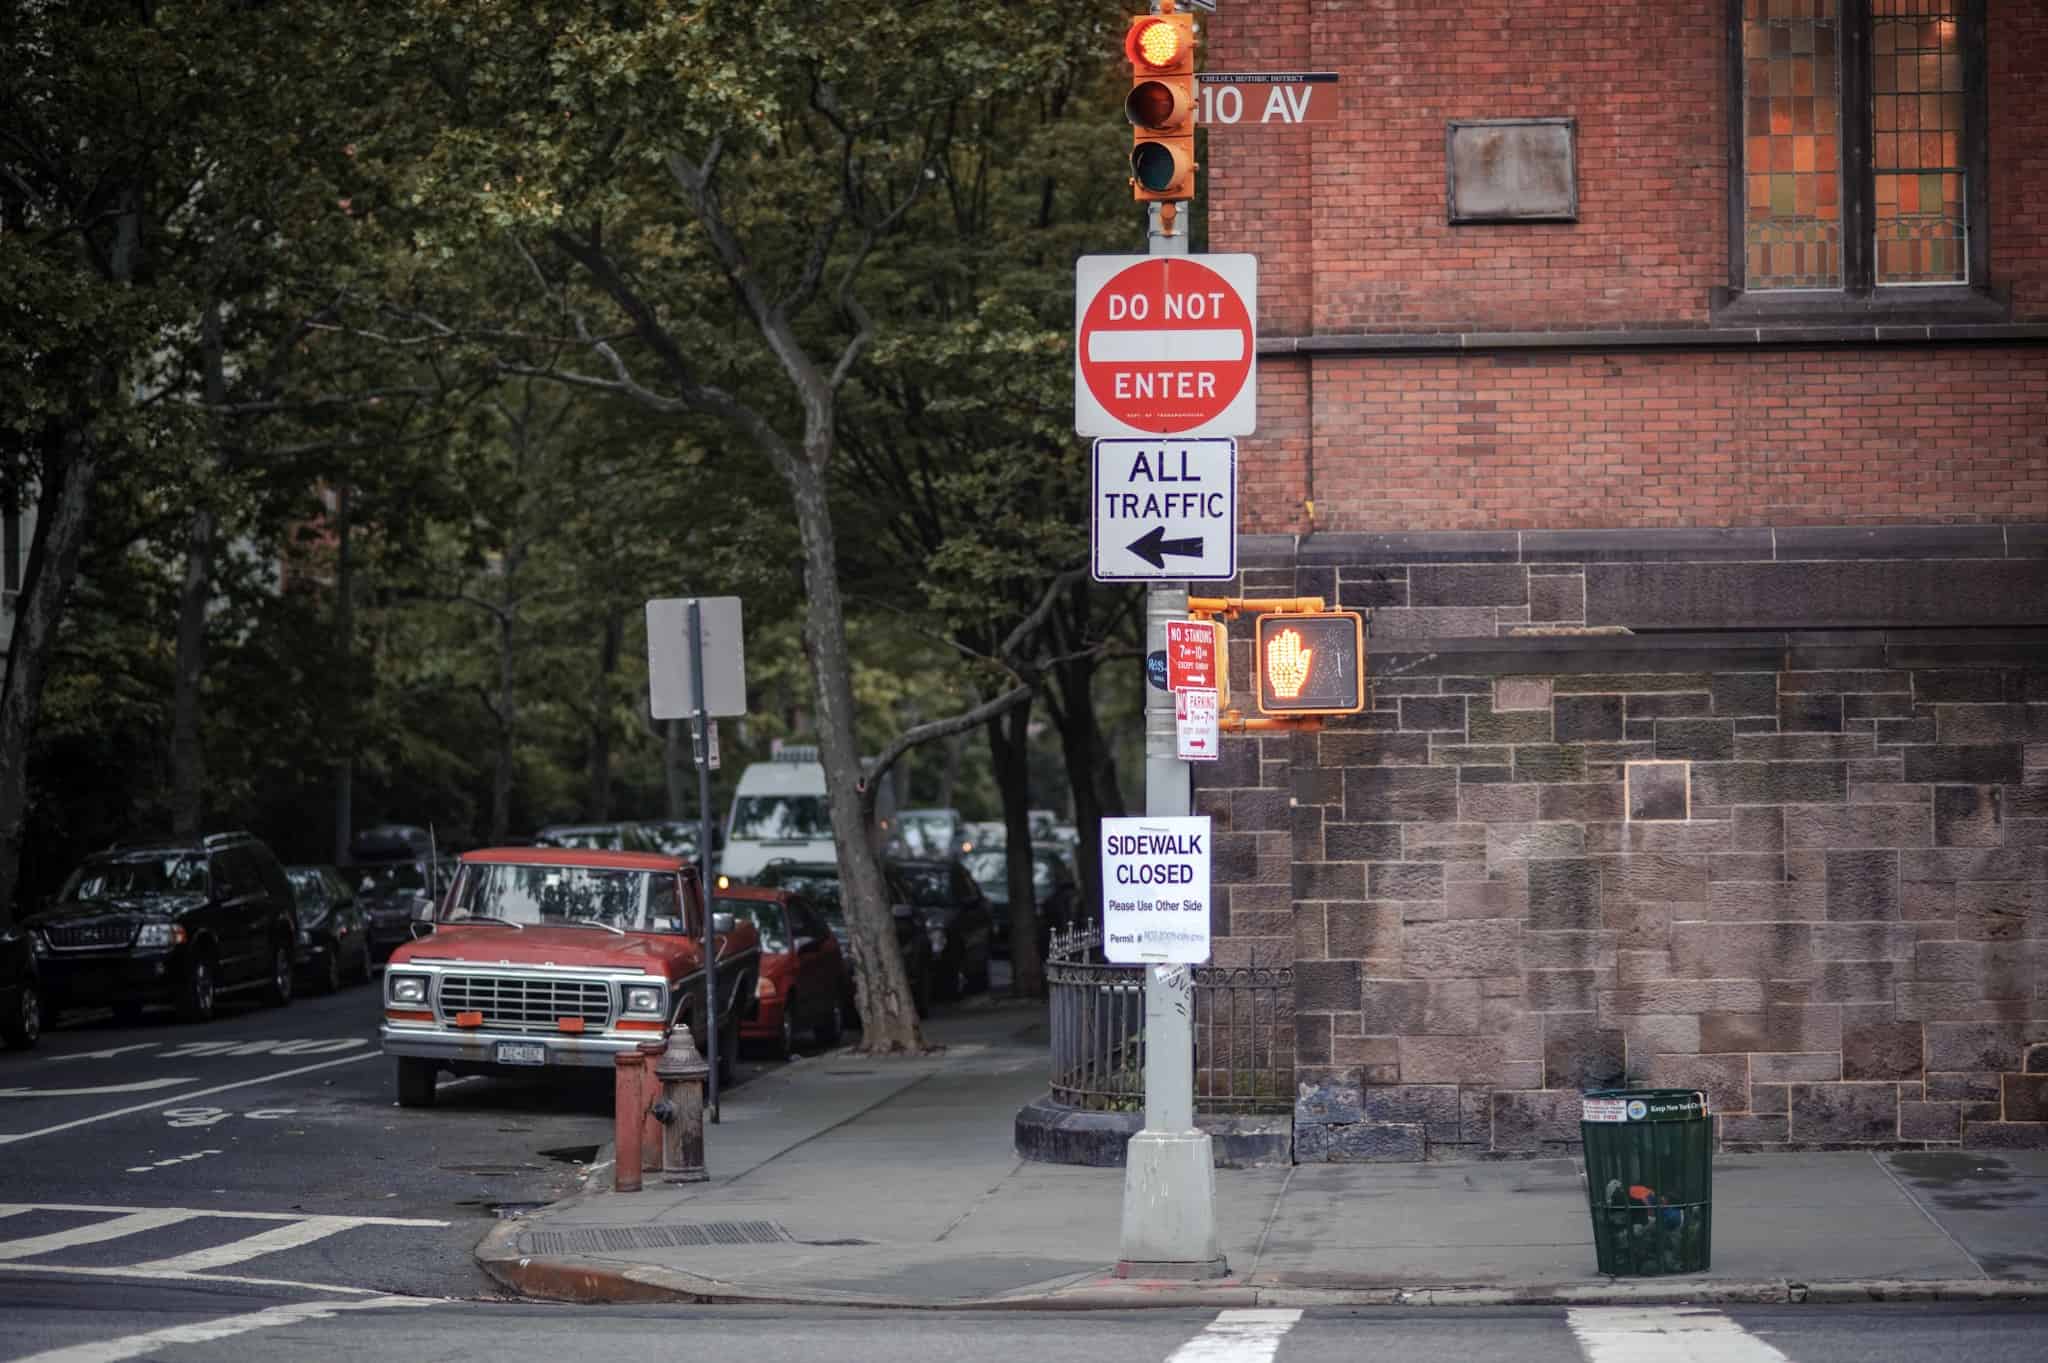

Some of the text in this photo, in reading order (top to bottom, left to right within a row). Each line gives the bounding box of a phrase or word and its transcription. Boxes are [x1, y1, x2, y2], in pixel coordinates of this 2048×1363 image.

[1202, 85, 1313, 124] 10 AV
[1109, 292, 1225, 320] DO NOT
[1115, 371, 1216, 399] ENTER
[1128, 451, 1201, 482] ALL
[1105, 493, 1224, 519] TRAFFIC
[1171, 628, 1212, 644] NO STANDING
[1190, 695, 1215, 709] PARKING
[1107, 834, 1202, 856] SIDEWALK
[1116, 864, 1193, 885] CLOSED
[1109, 899, 1203, 912] Please Use Other Side
[1110, 933, 1135, 944] Permit
[1650, 1105, 1666, 1113] Keep
